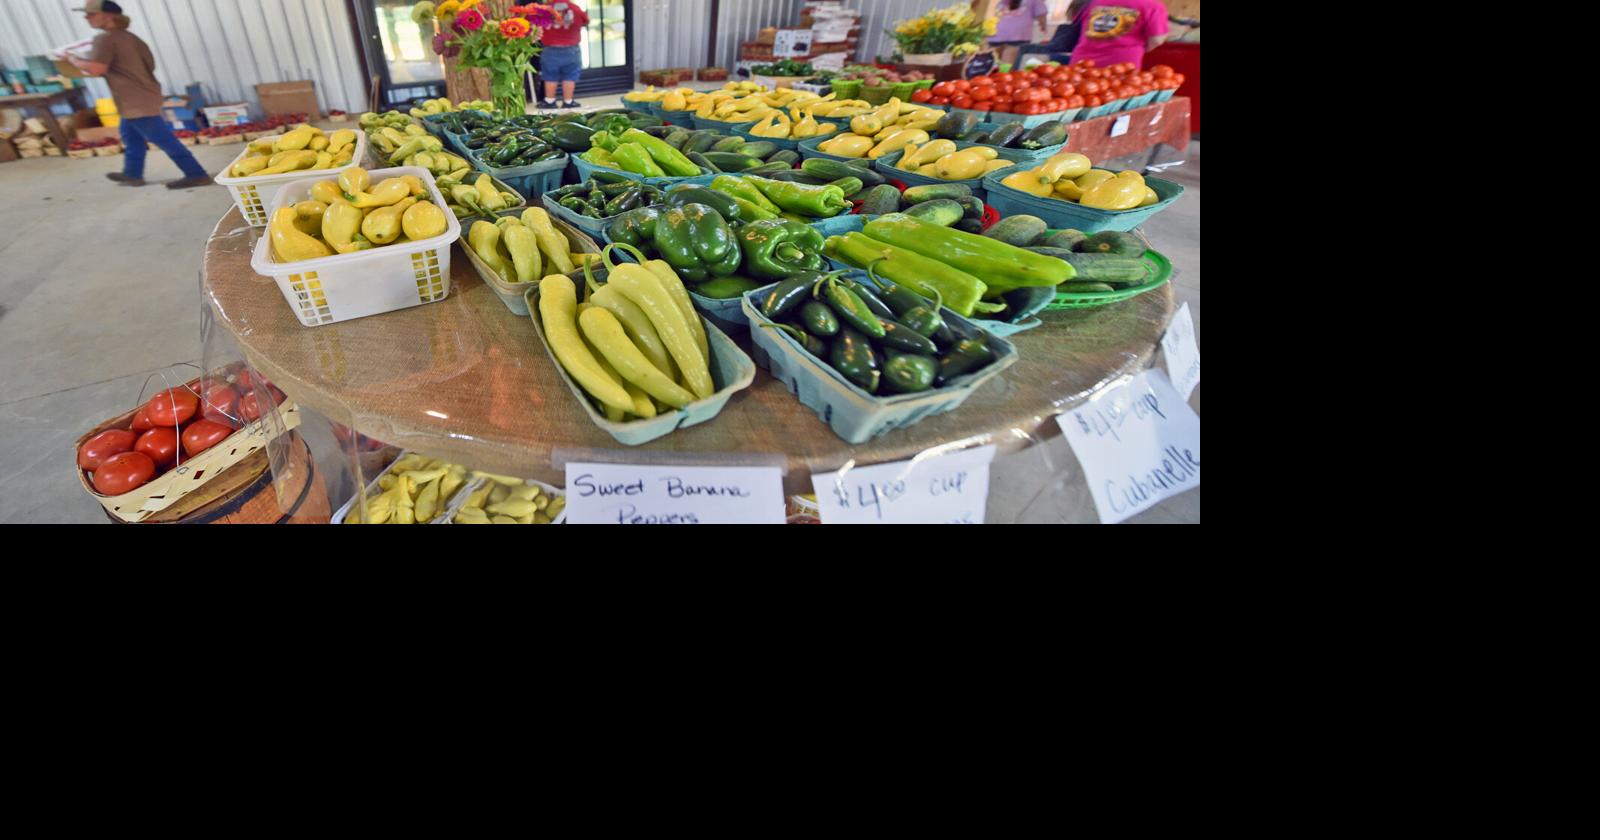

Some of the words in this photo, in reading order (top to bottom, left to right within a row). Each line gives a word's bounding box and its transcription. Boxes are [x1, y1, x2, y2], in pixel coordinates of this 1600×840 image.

[574, 474, 644, 496] Sweet
[660, 476, 750, 498] Banana
[1105, 445, 1200, 514] Cubanelle
